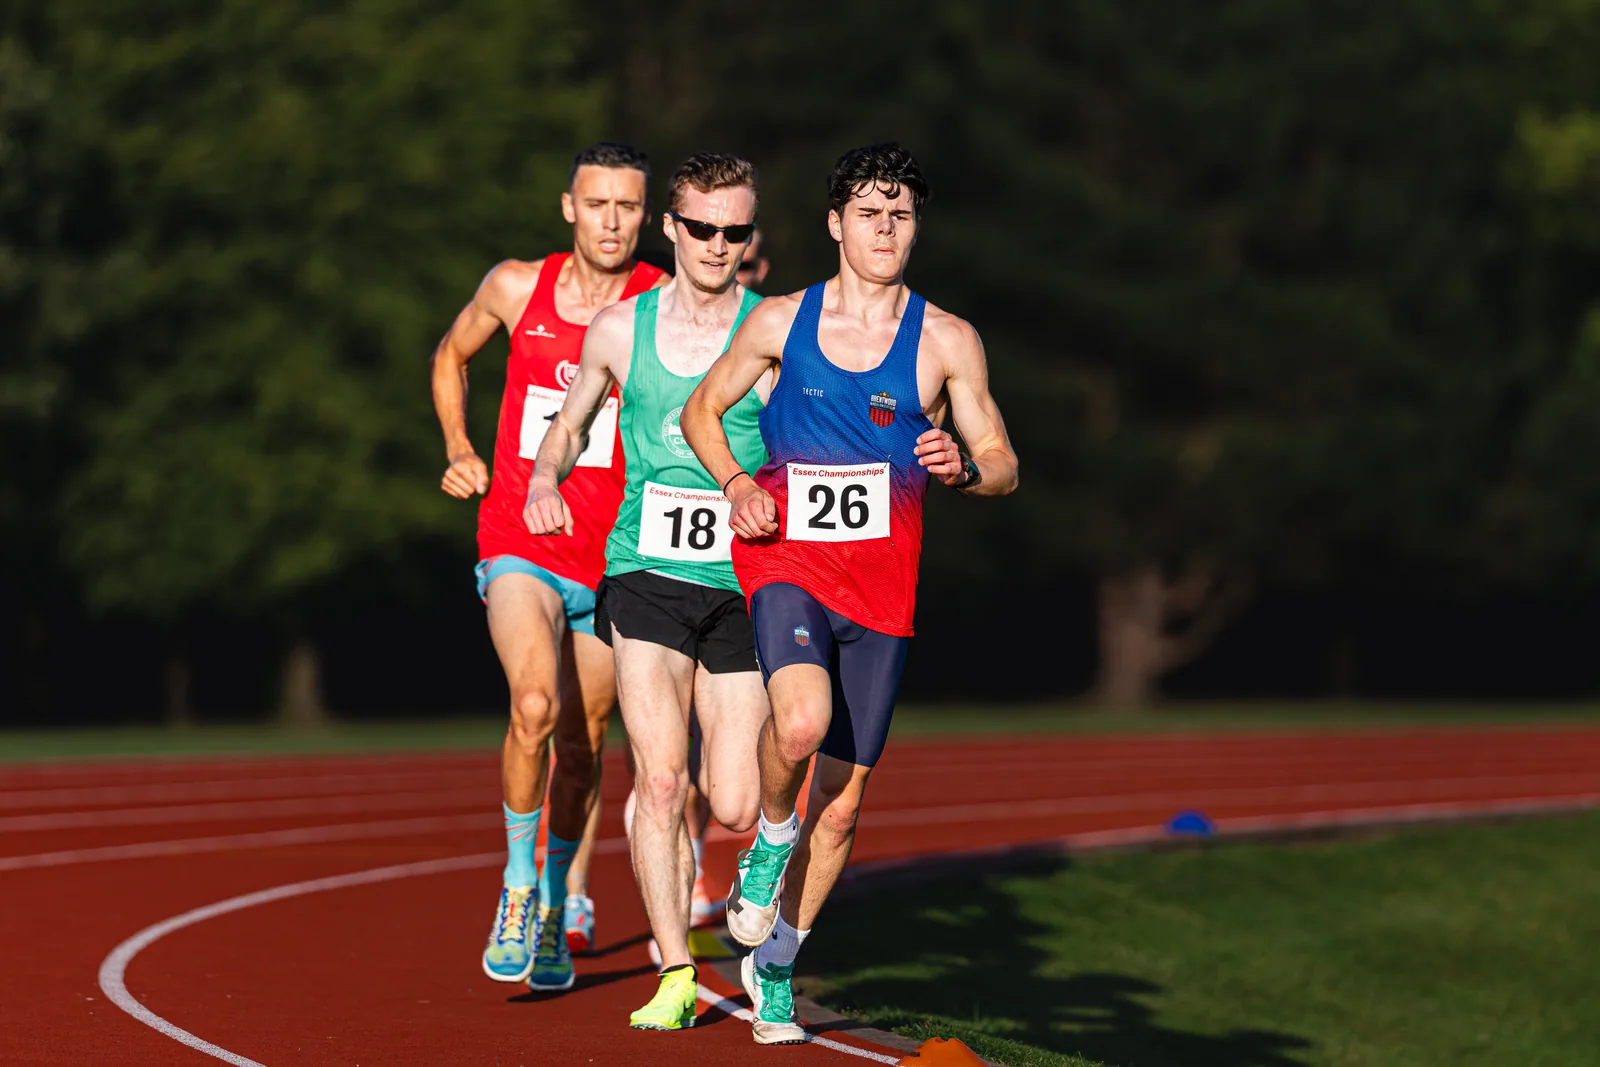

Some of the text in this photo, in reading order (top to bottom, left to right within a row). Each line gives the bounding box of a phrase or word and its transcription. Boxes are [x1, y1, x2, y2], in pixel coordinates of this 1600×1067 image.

[792, 467, 885, 479] Essex Championships
[649, 486, 730, 504] Essex Championsh
[808, 483, 870, 530] 26
[663, 506, 717, 551] 18
